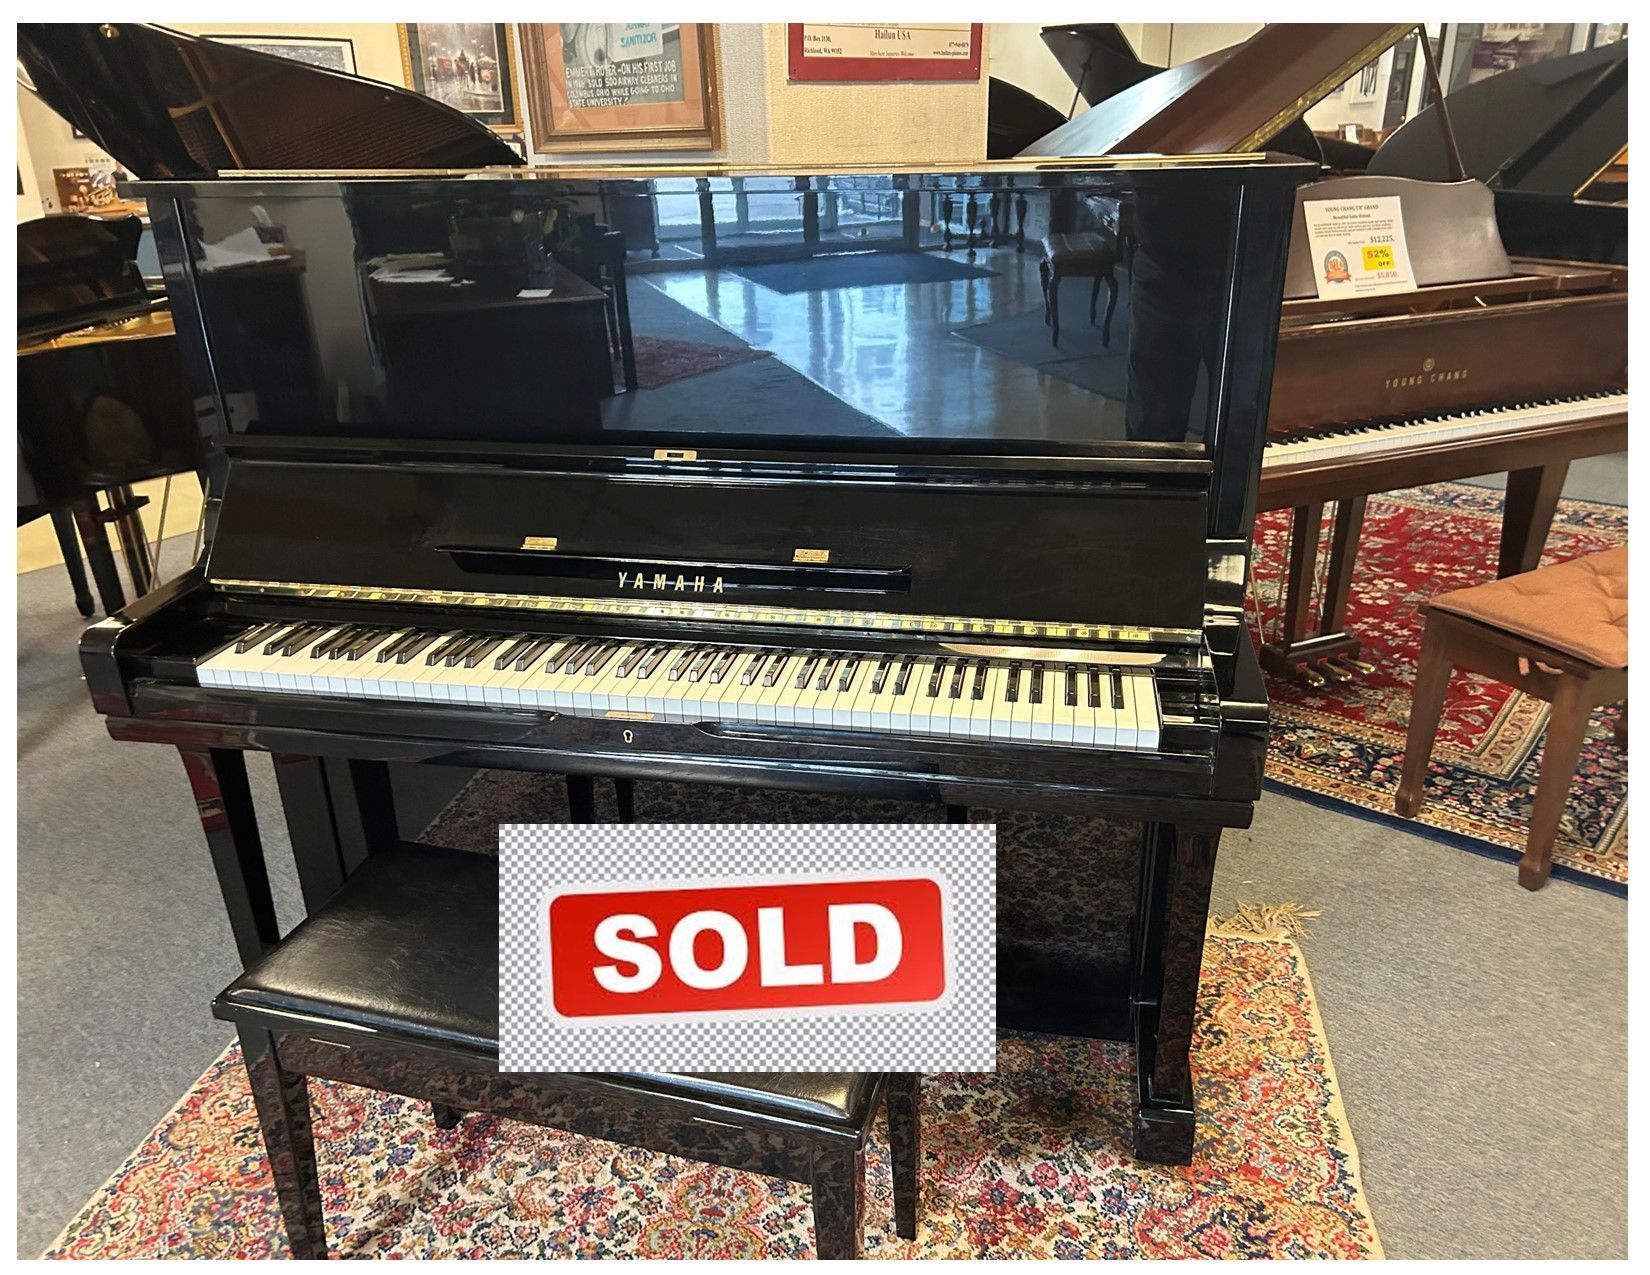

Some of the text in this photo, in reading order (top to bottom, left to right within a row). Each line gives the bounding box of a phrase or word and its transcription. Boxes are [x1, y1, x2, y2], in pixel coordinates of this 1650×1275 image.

[620, 32, 657, 48] SANITIZOR
[875, 29, 911, 40] Hailun USA
[631, 61, 643, 74] HIS
[643, 60, 663, 73] FIRST
[663, 59, 677, 72] JOB
[588, 78, 603, 88] SOLD
[618, 75, 639, 86] AIRWAY
[640, 73, 668, 85] CLEANERS
[630, 85, 650, 95] GOING
[651, 85, 660, 94] TO
[660, 84, 675, 93] OHIO
[1367, 249, 1389, 259] 52%
[1385, 369, 1467, 389] YOUNG CHANG
[618, 571, 724, 593] YAMAHA
